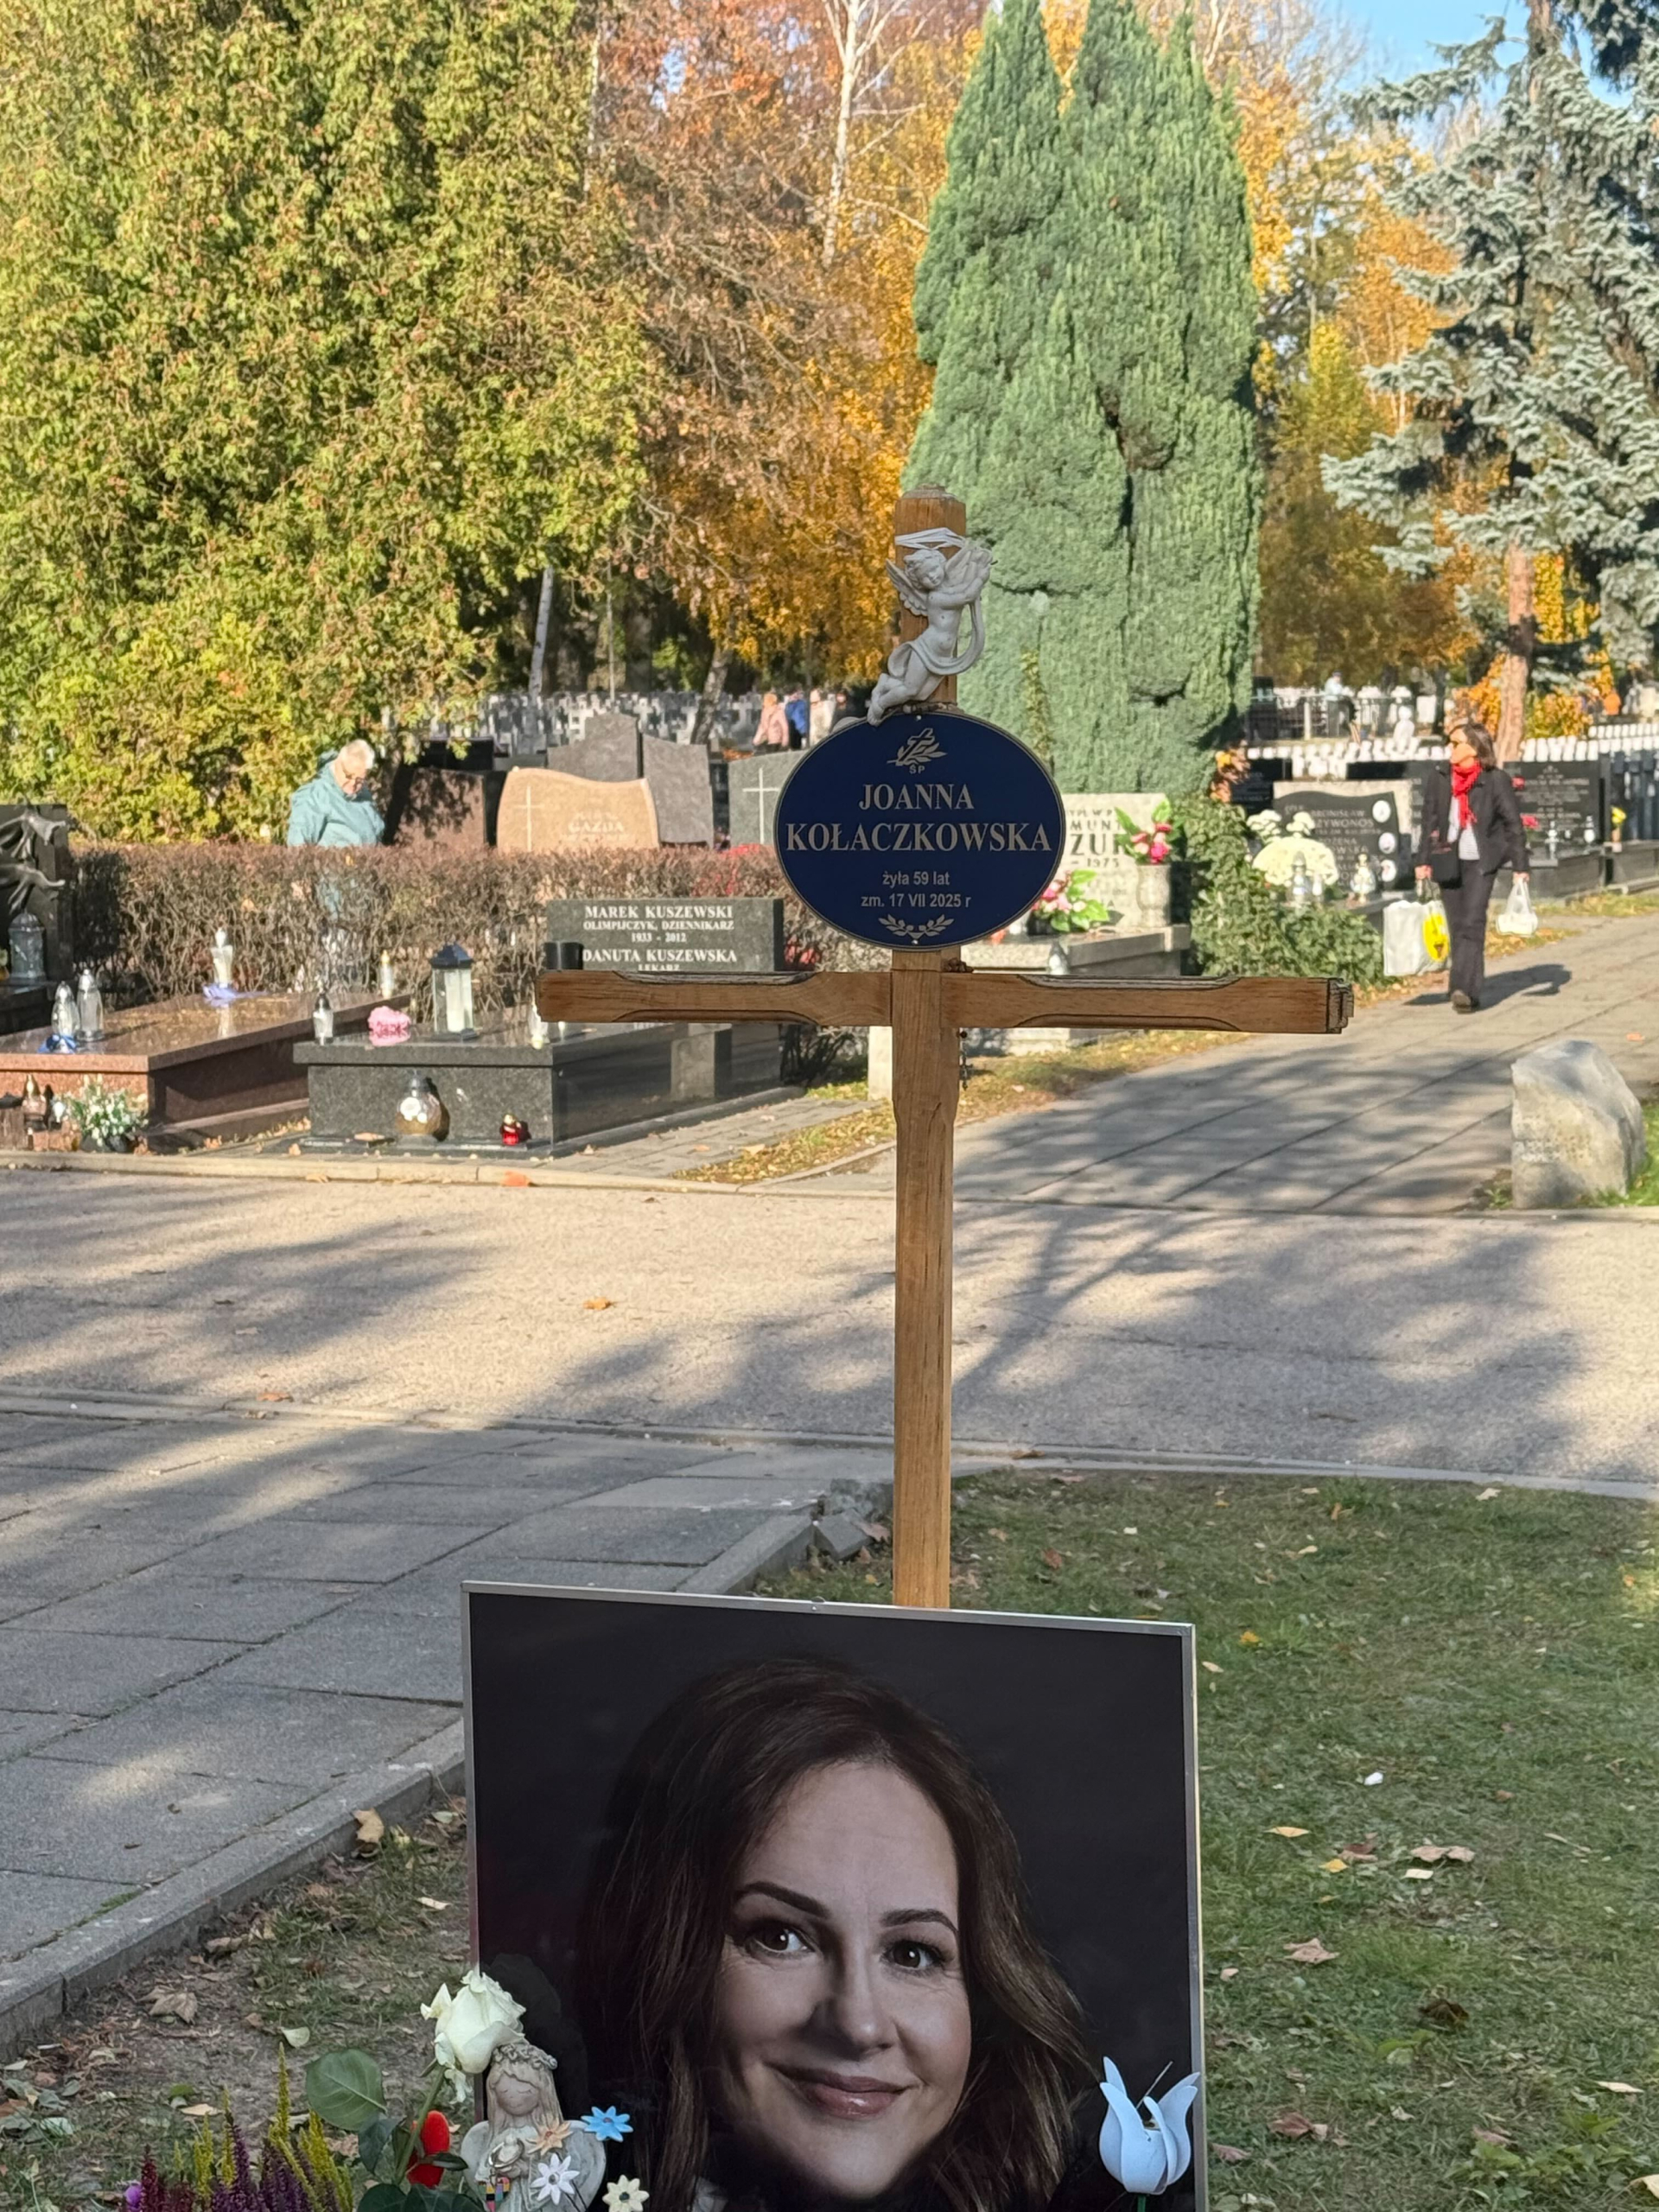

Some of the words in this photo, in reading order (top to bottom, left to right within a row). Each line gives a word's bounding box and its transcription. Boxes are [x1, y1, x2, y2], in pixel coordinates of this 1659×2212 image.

[859, 784, 975, 810] JOANNA
[785, 823, 1052, 851] KOŁACZKOWSKA
[882, 871, 909, 887] żyła
[913, 871, 930, 886] 59
[933, 871, 950, 886] lat
[861, 897, 885, 907] zm.
[889, 894, 904, 907] 17
[908, 894, 925, 907] VII
[930, 894, 962, 908] 2025
[584, 906, 639, 918] MAREK
[645, 906, 733, 918] KUSZEWSKI
[662, 920, 735, 931] DZIENNIKARZ
[631, 932, 652, 943] 1933
[664, 932, 687, 943] 2012
[582, 950, 641, 962] DANUTA
[646, 950, 737, 962] KUSZEWSKA
